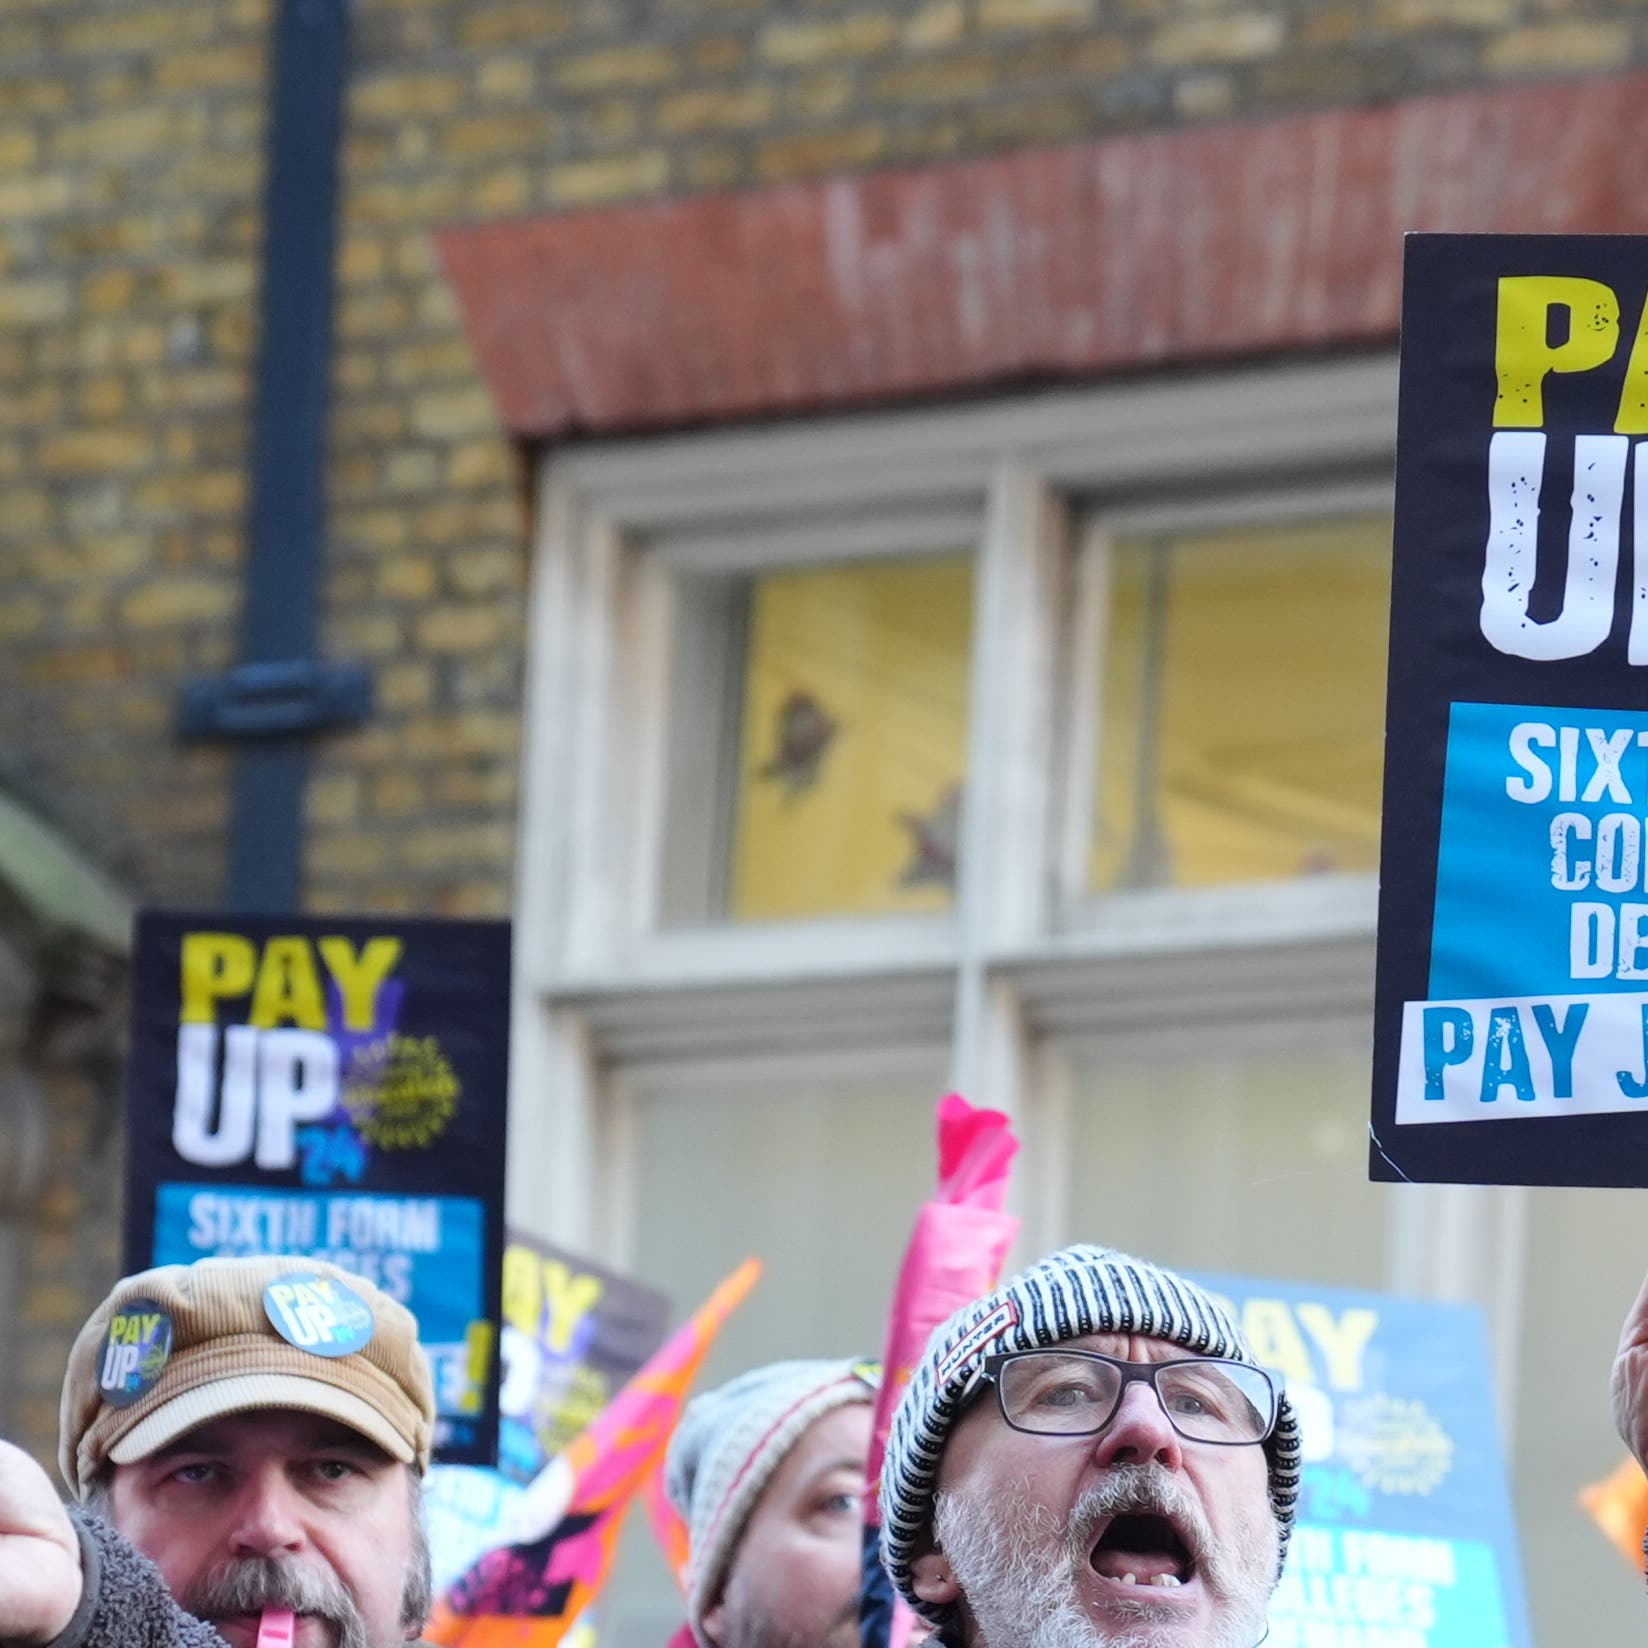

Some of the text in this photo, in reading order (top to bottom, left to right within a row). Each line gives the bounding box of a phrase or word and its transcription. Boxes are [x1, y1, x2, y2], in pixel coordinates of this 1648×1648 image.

[180, 932, 405, 1032] PAY
[1422, 1002, 1590, 1103] PAY
[172, 1023, 340, 1170] UP
[189, 1194, 442, 1254] SIXTH FORM
[110, 1313, 161, 1346] PAY
[268, 1280, 338, 1308] PAY
[284, 1302, 337, 1345] UP
[502, 1245, 601, 1352] AY
[101, 1344, 140, 1391] UP
[1224, 1291, 1379, 1392] AY
